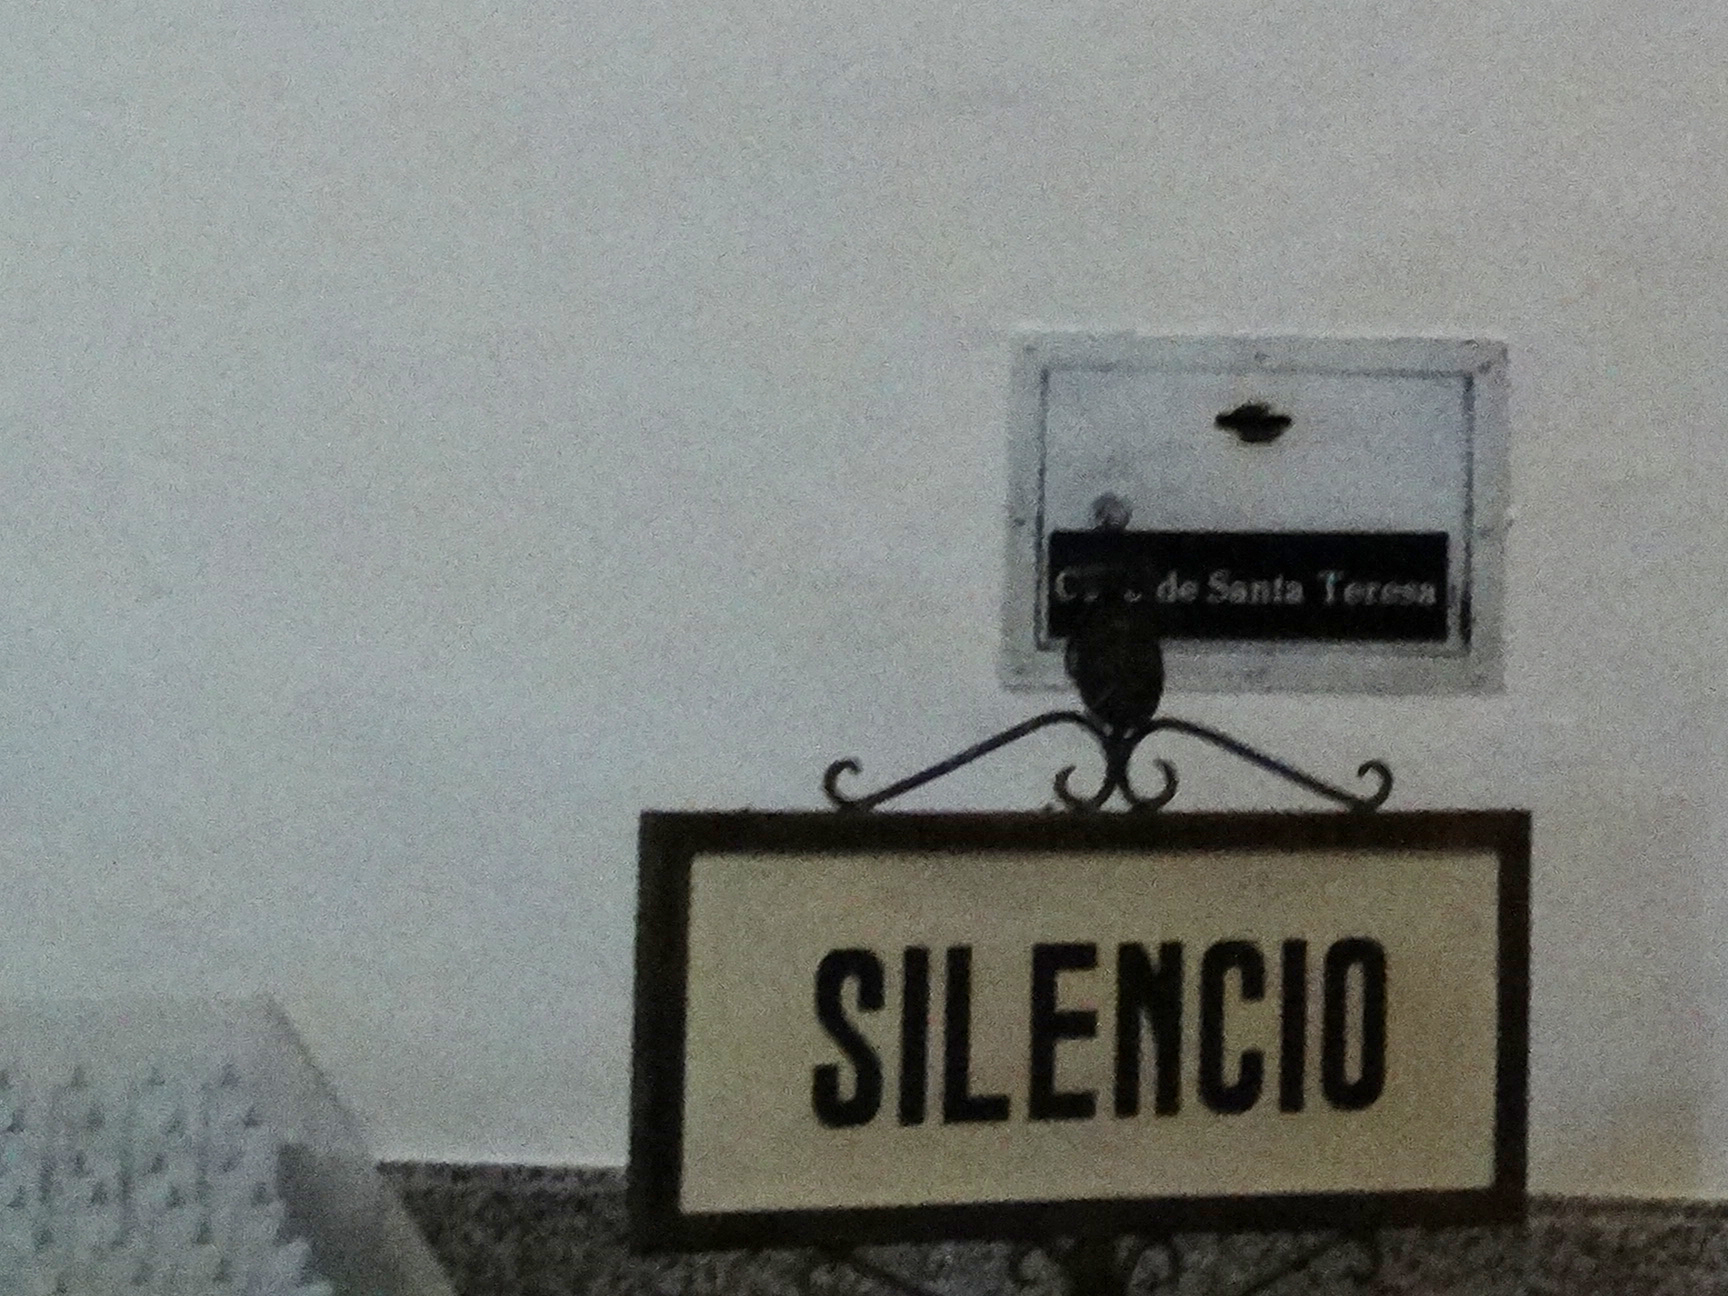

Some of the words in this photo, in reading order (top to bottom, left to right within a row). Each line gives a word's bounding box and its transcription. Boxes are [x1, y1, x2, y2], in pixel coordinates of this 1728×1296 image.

[1155, 568, 1199, 605] de
[1206, 567, 1304, 606] Santa
[1316, 567, 1438, 607] Teresa
[811, 937, 1388, 1130] SILENCIO
